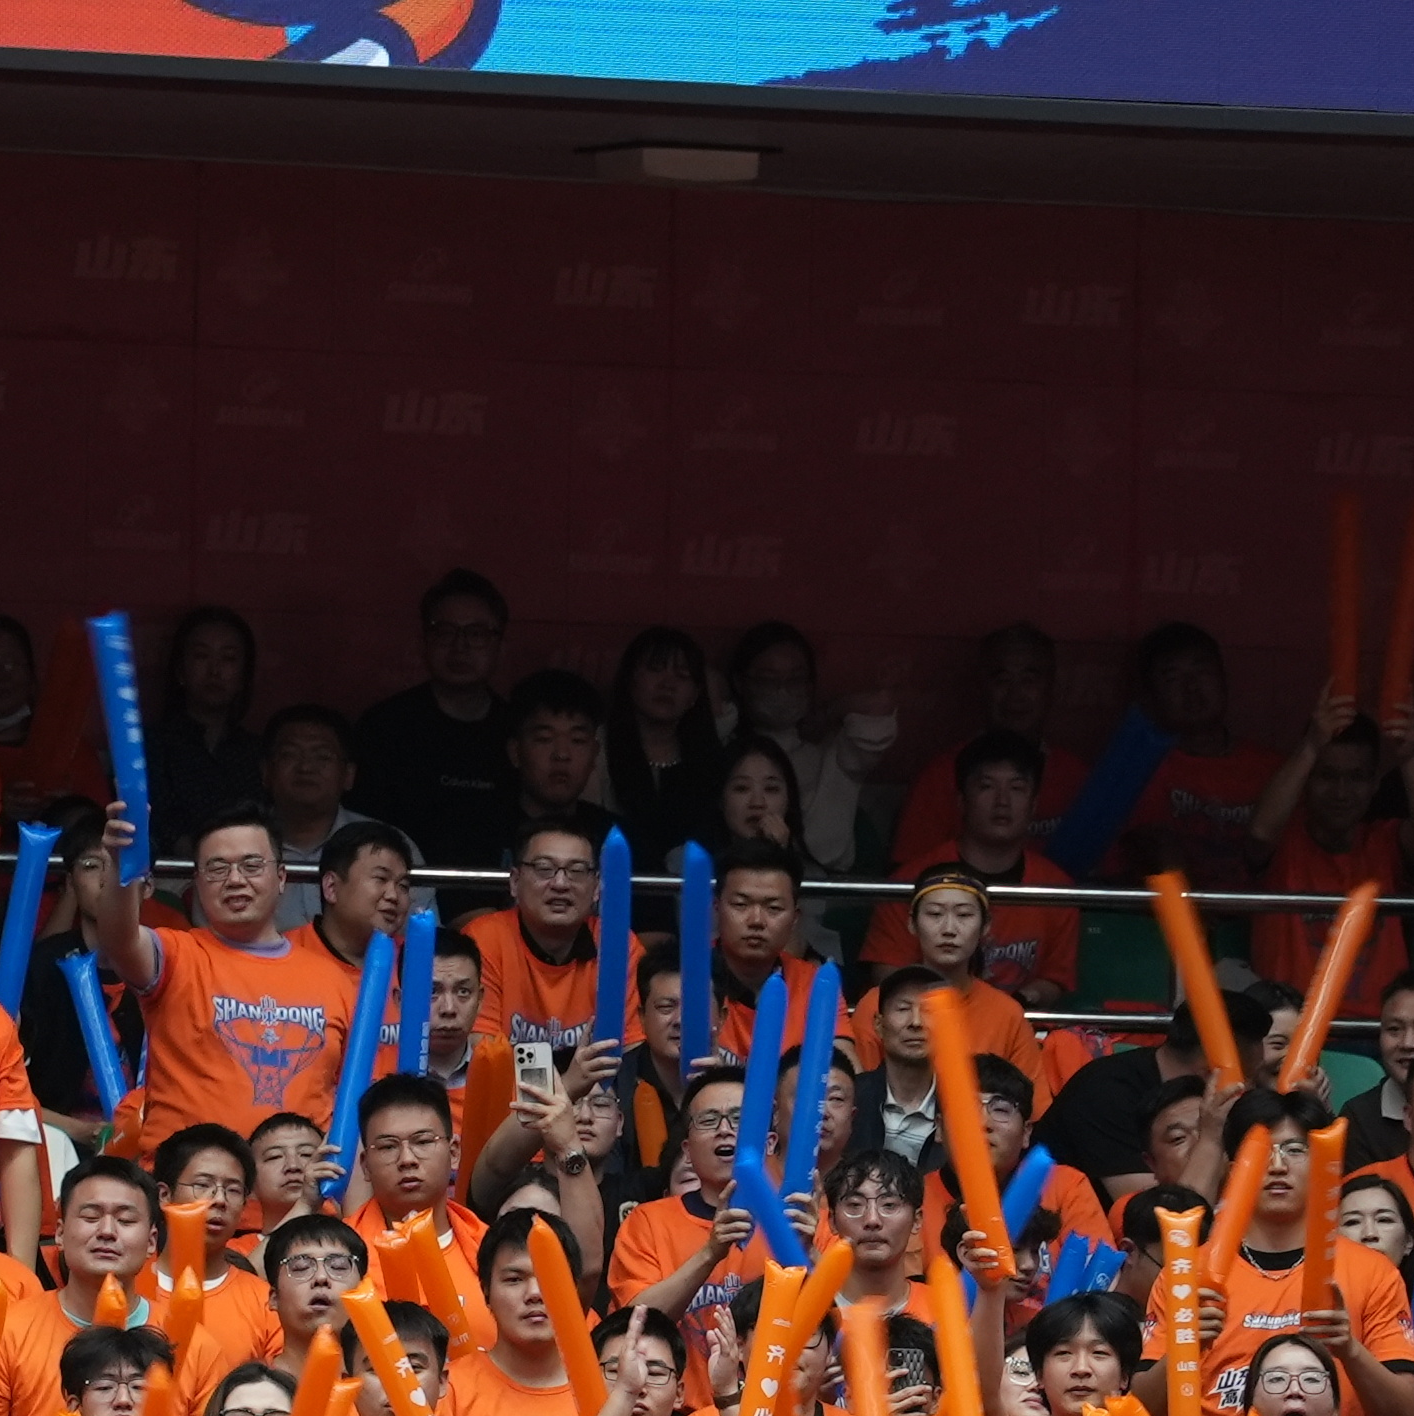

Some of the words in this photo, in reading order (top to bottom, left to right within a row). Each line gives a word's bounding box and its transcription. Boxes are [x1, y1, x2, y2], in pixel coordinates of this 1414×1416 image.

[214, 995, 326, 1037] SHANDONG
[510, 1013, 597, 1048] SHANDON
[1171, 1256, 1193, 1276] 齐
[1174, 1309, 1196, 1346] 必胜
[766, 1343, 786, 1365] 齐
[1176, 1360, 1198, 1375] 山东
